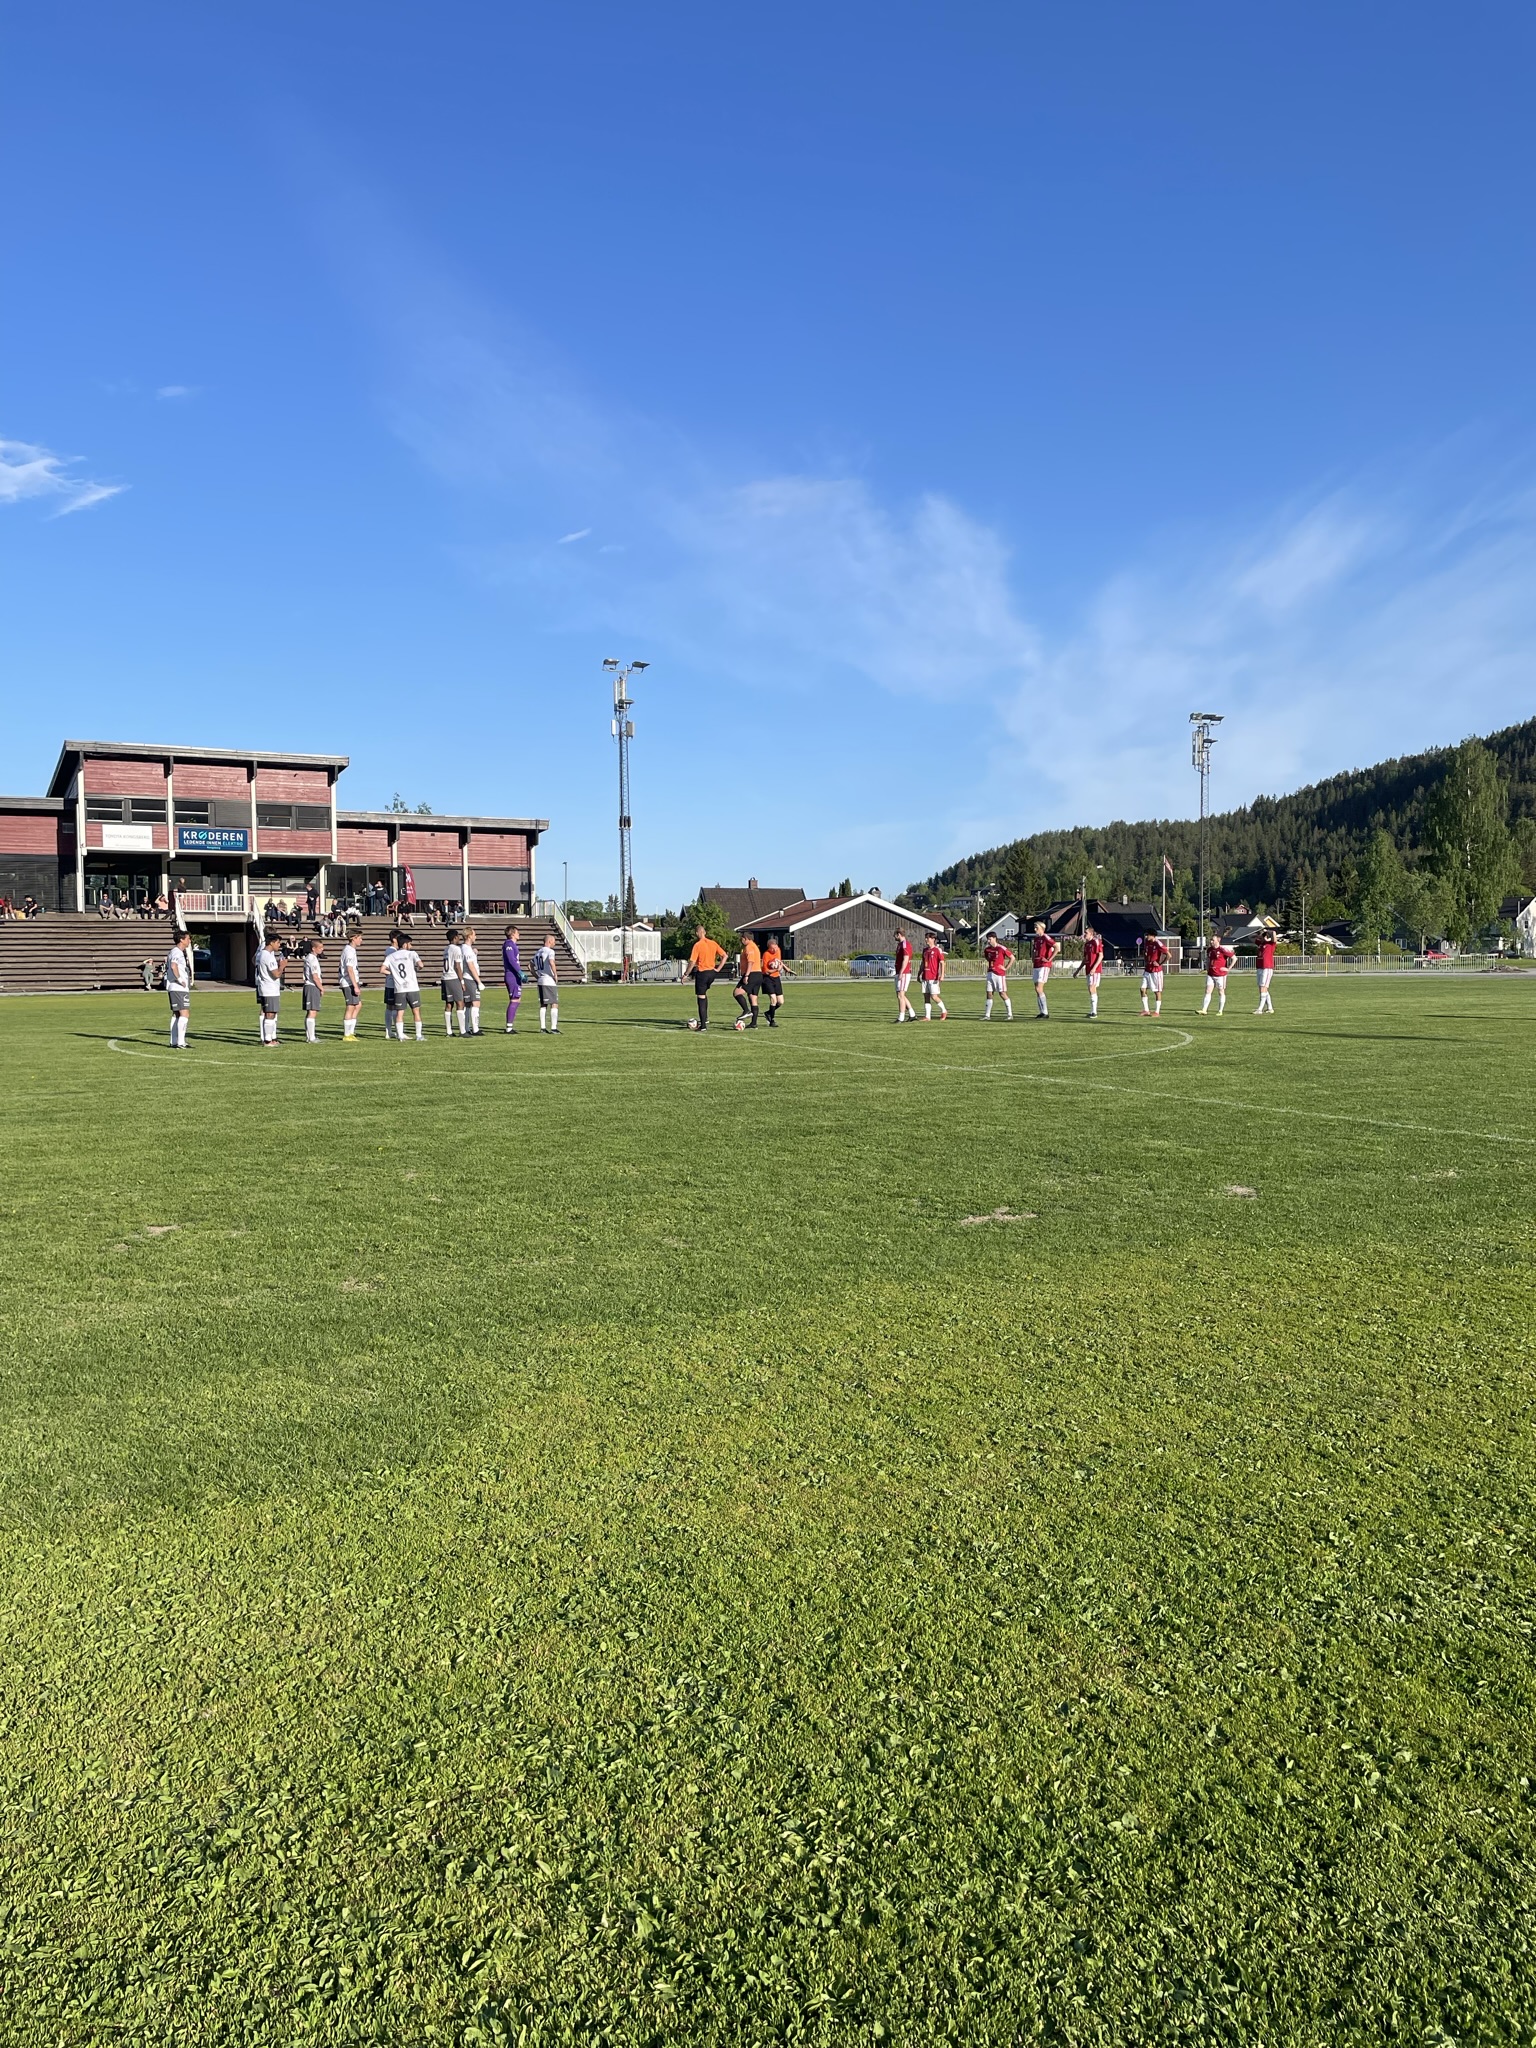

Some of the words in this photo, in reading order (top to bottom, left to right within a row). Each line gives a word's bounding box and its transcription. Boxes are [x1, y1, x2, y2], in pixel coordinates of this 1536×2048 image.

[183, 831, 243, 841] KRØDEREN
[535, 955, 544, 970] 10
[398, 963, 407, 979] 8
